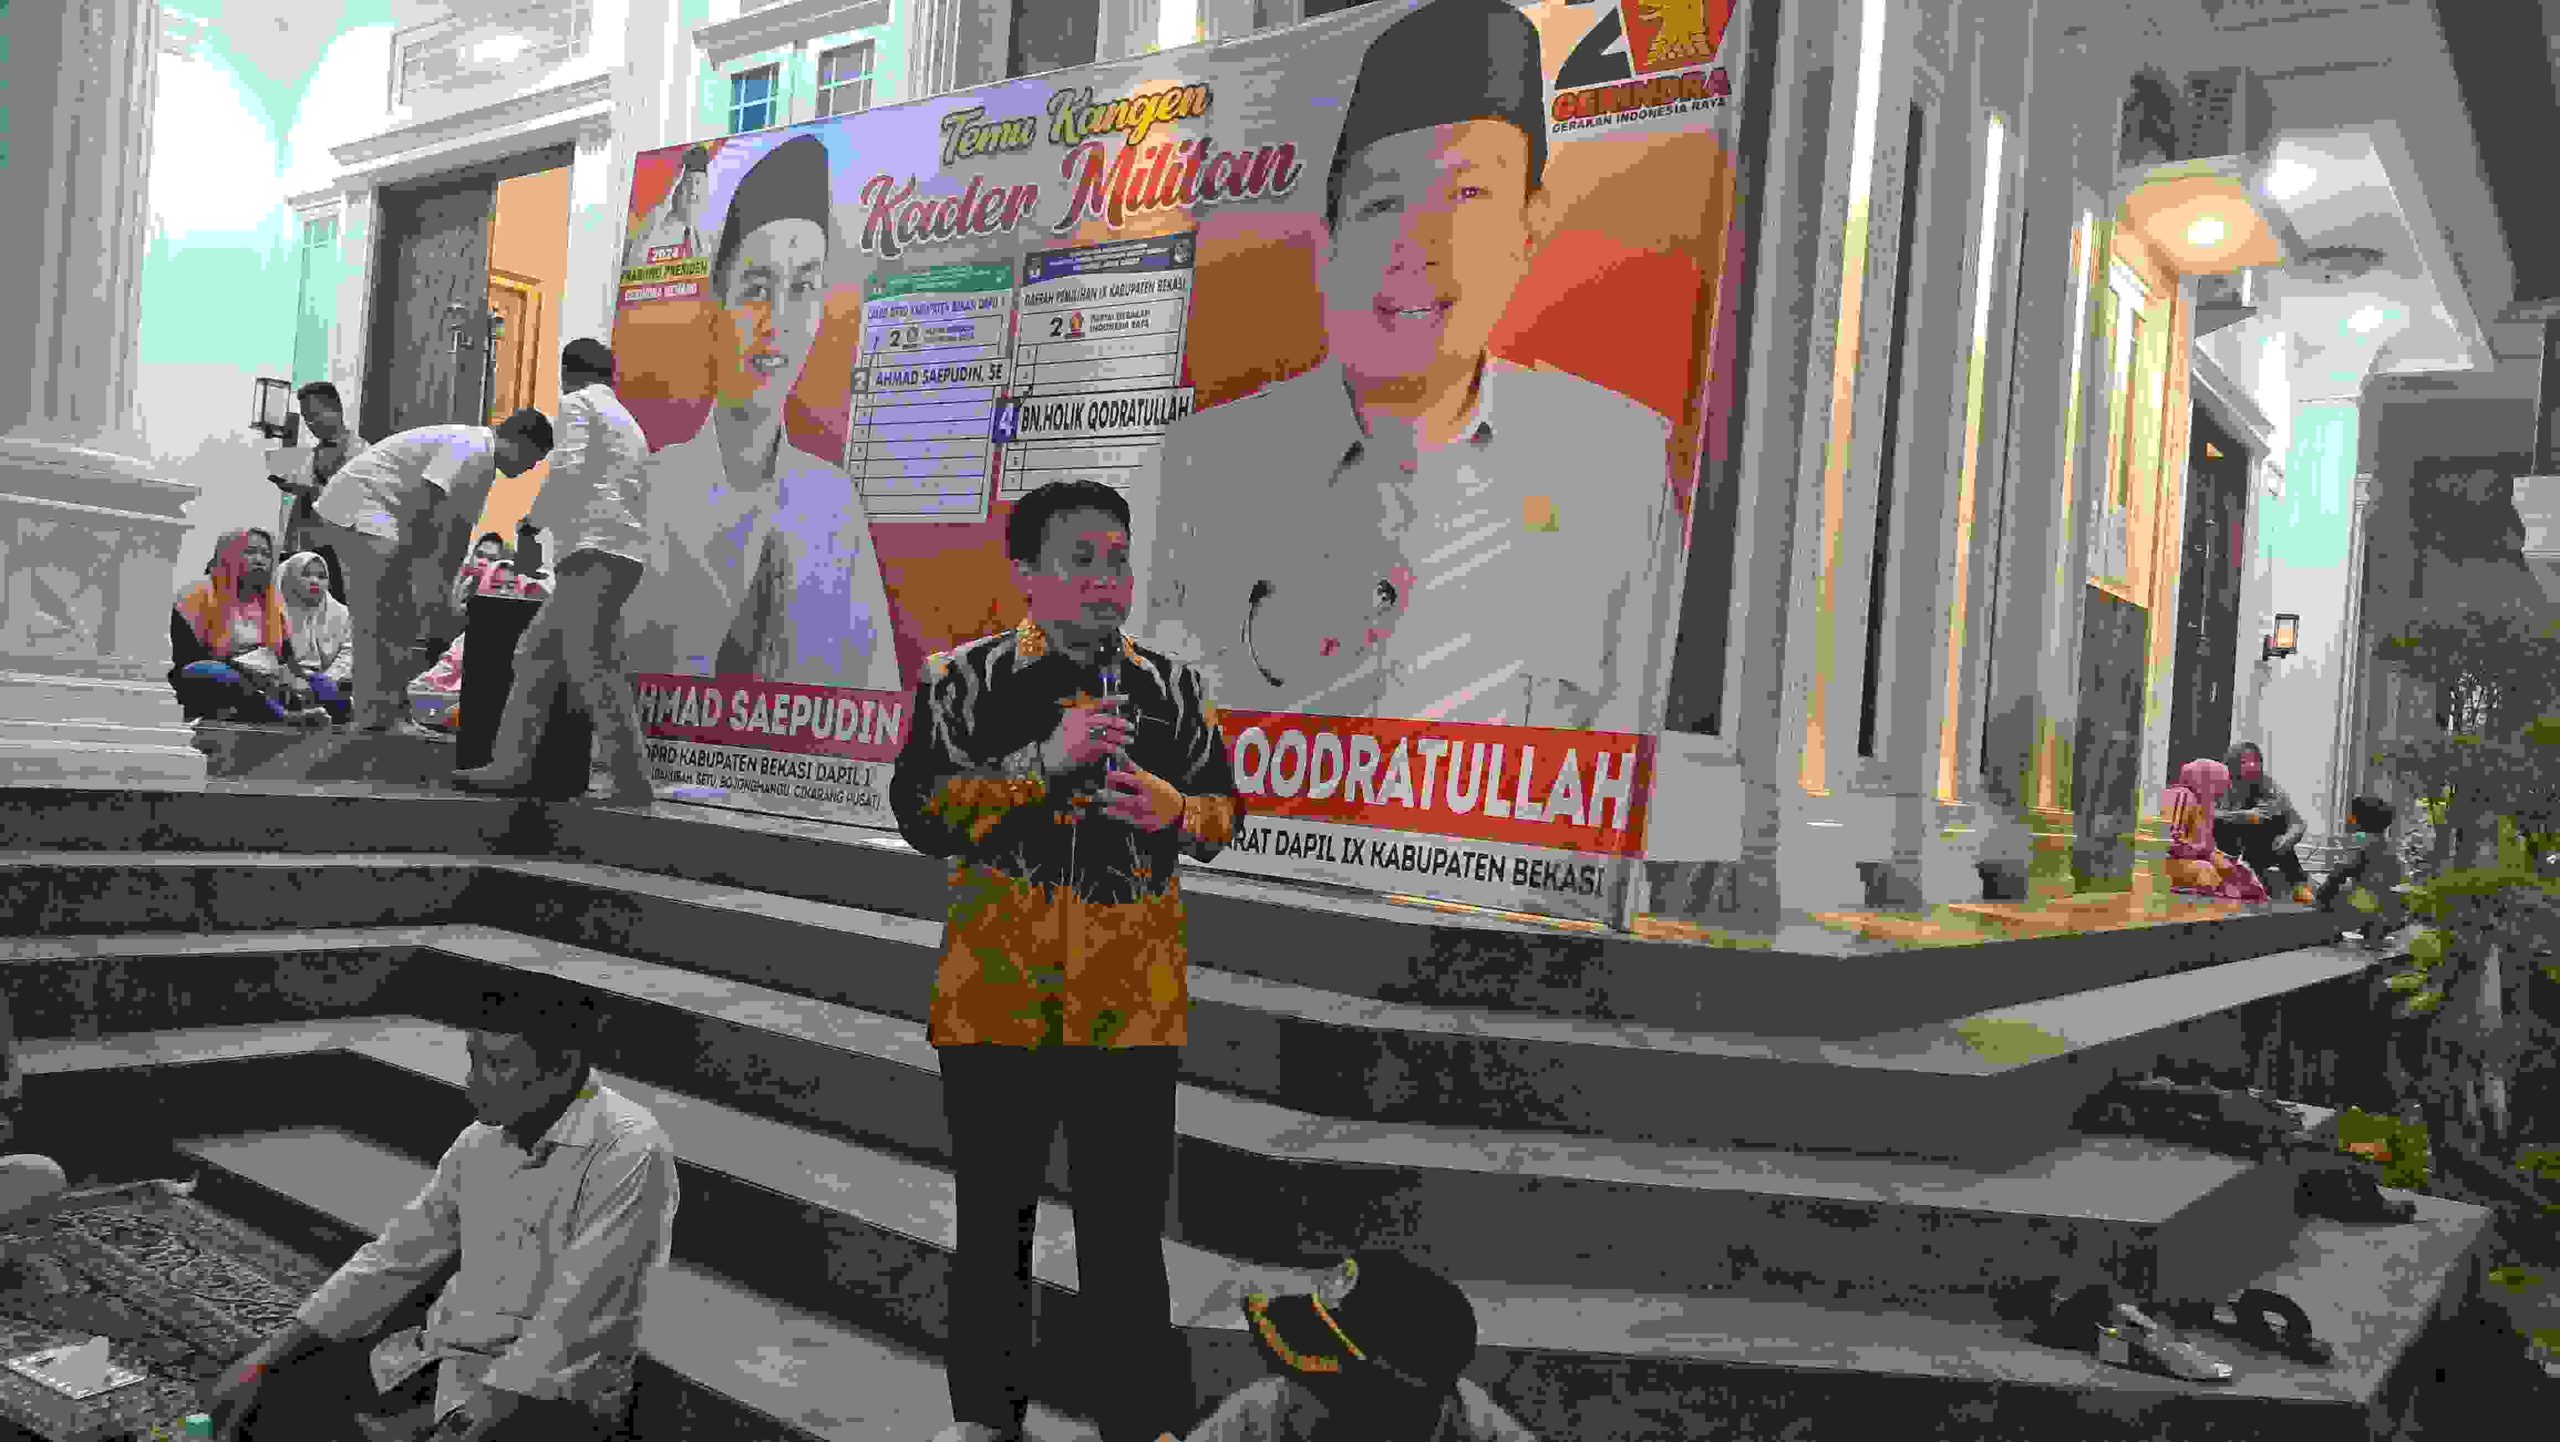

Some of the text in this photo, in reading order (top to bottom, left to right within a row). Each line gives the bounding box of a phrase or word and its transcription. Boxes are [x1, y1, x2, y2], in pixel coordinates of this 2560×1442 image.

[1552, 66, 1731, 121] GERINDRA
[1552, 97, 1727, 133] GERAKAN INDONESIA RAYA
[941, 85, 1213, 166] Temu Kangen
[859, 138, 1302, 259] Kader Militan
[889, 329, 901, 347] 2
[1050, 317, 1063, 337] 2
[876, 370, 919, 386] AHMAD
[1088, 396, 1190, 432] QODRATULLAH
[729, 689, 902, 744] SAEPUDIN
[680, 748, 757, 772] KABUPATEN
[760, 757, 814, 780] BEKASI
[816, 763, 860, 786] DAPIL
[1234, 726, 1637, 830] QODRATULLAH
[1275, 830, 1336, 862] DAPIL
[1341, 836, 1365, 867] IX
[1370, 840, 1506, 883] KABUPATEN
[1513, 857, 1604, 897] BEKASI
